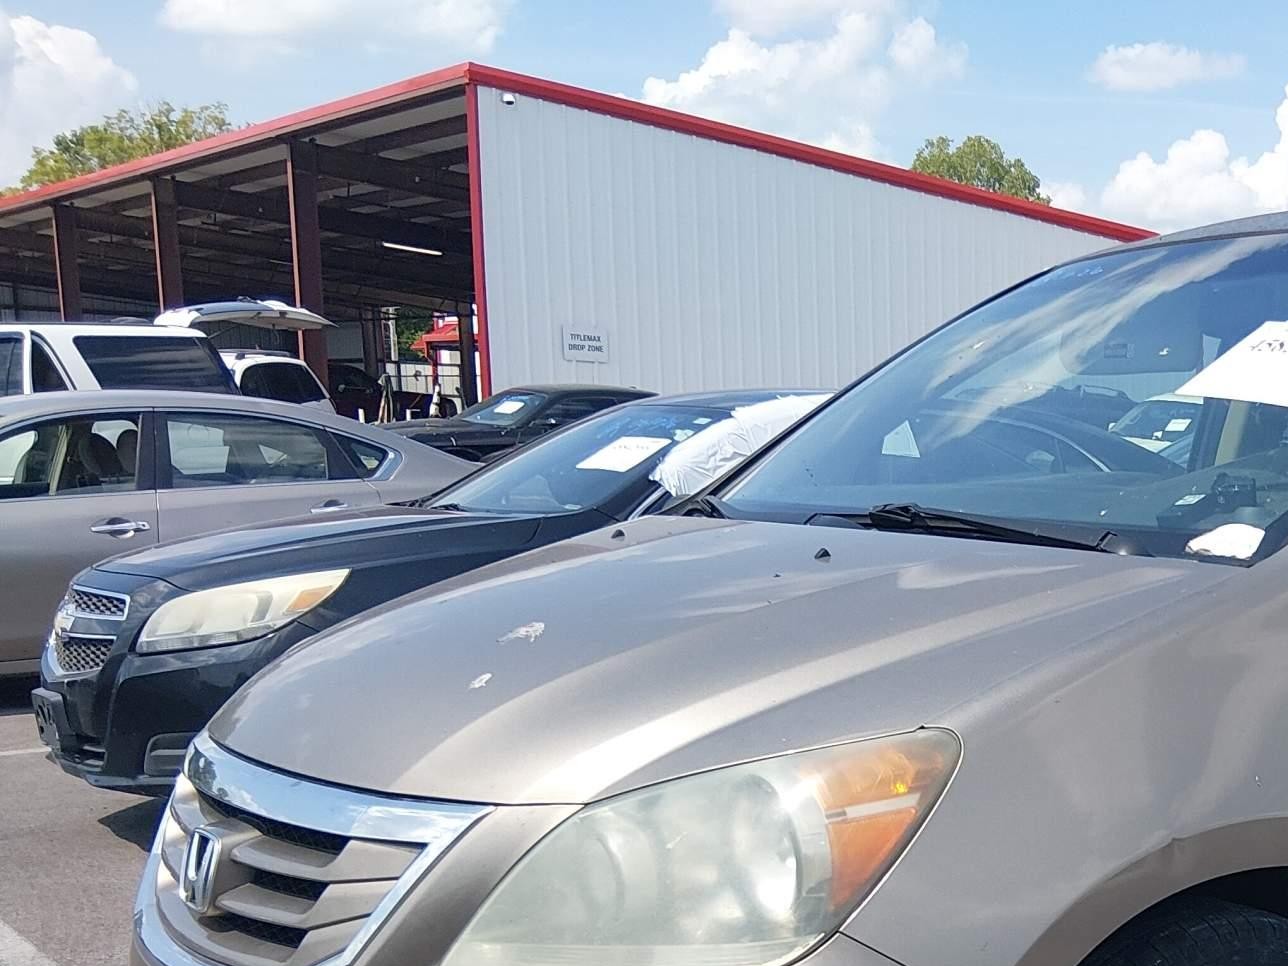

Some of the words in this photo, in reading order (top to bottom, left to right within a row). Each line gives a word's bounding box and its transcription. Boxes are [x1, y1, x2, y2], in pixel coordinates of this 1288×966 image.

[570, 333, 602, 342] TITLEMAX
[568, 343, 586, 351] DROP
[587, 344, 604, 353] ZONE
